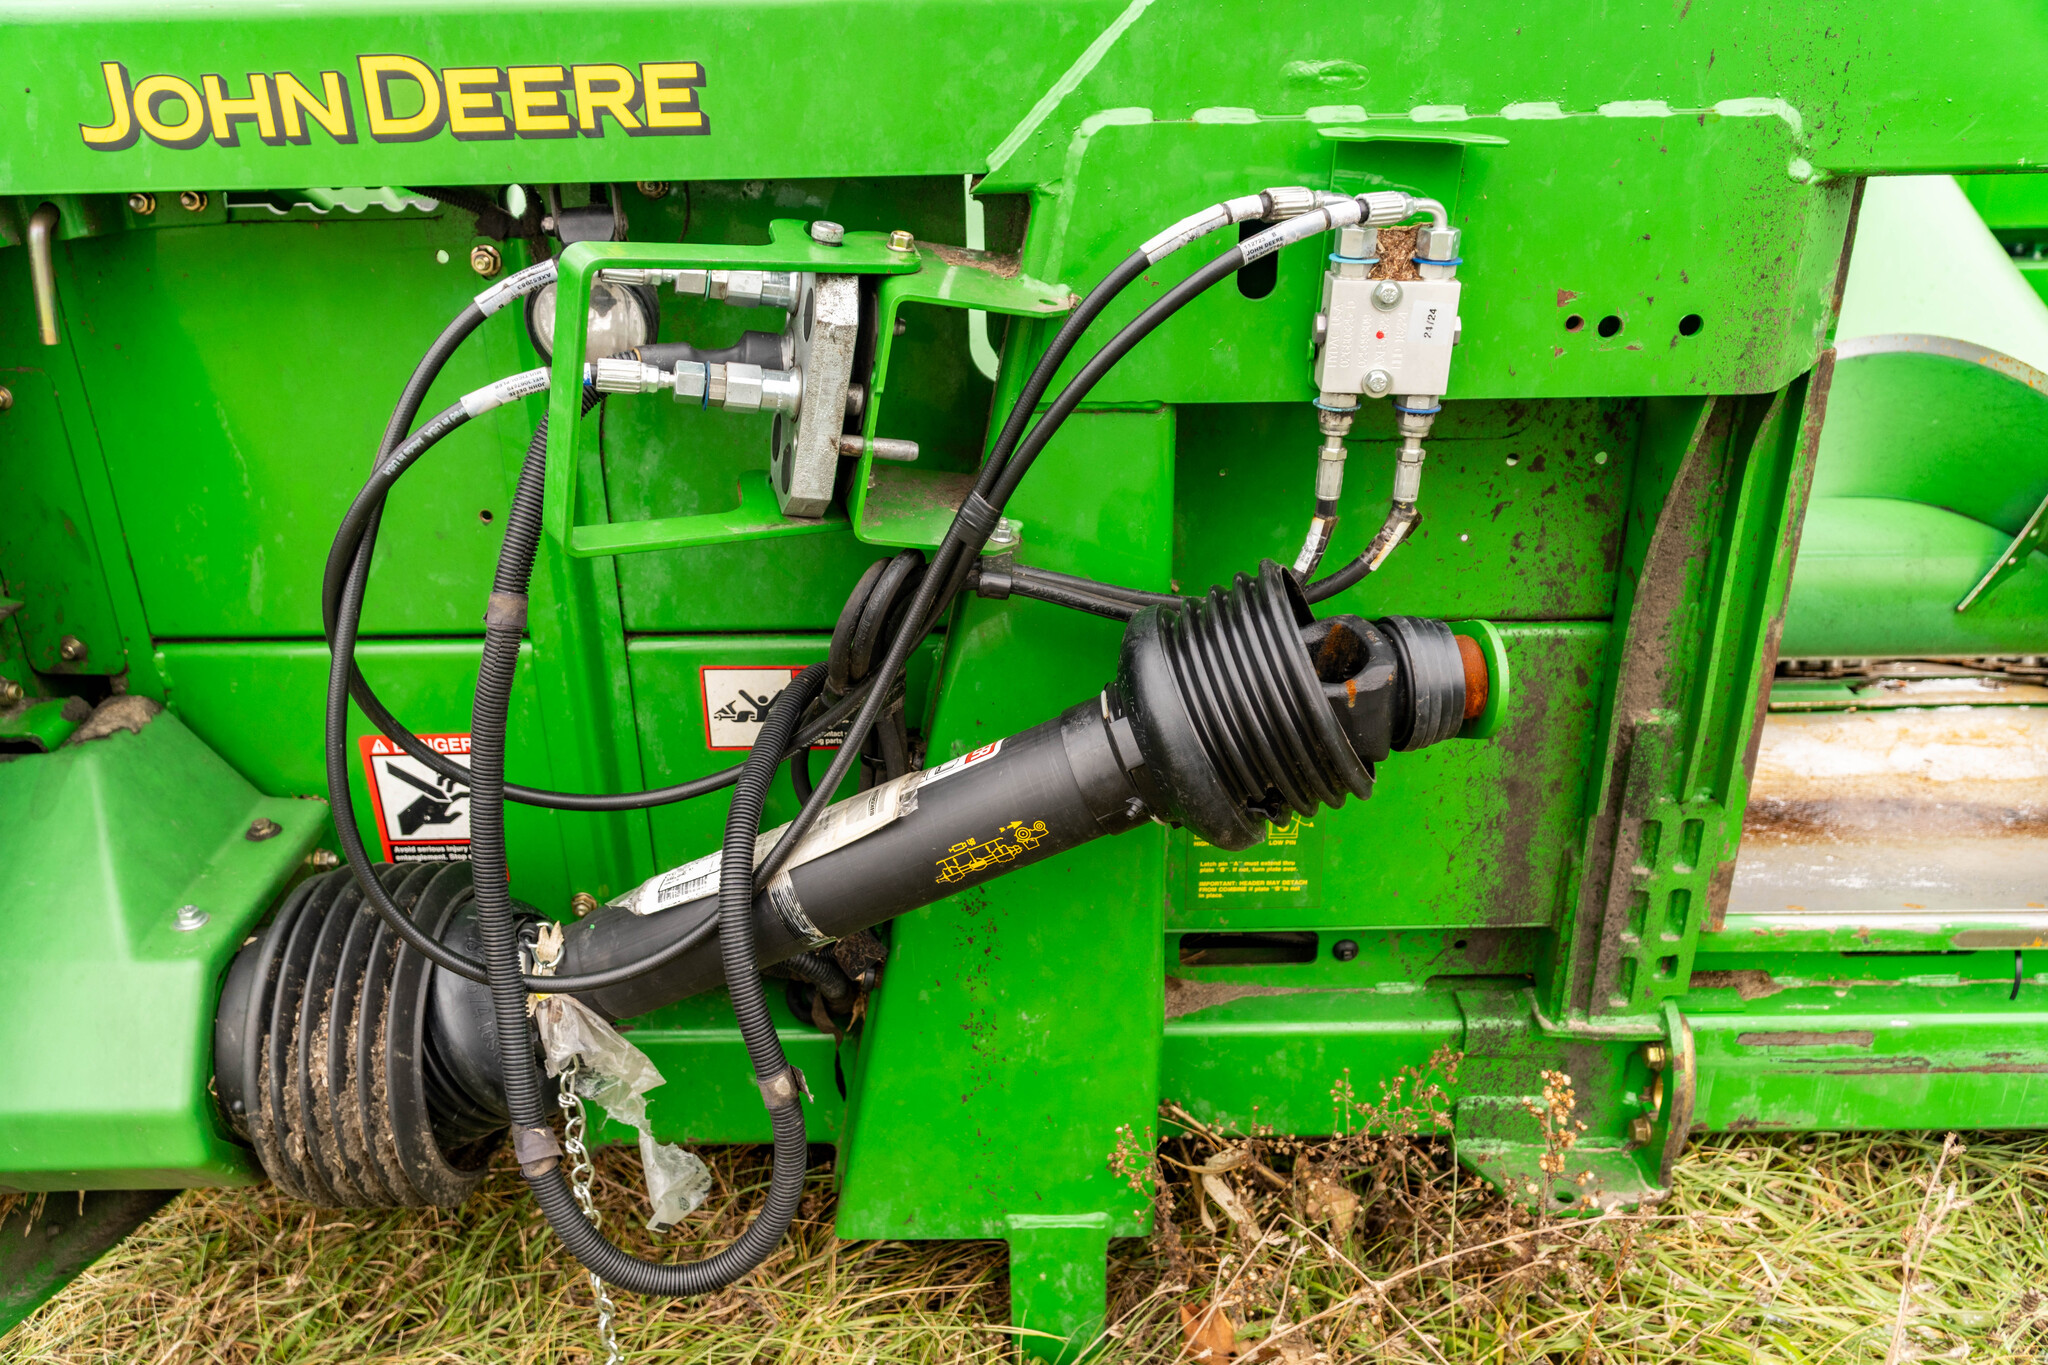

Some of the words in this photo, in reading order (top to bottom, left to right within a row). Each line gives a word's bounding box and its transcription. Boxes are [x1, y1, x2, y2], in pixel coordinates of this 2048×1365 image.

[80, 61, 357, 150] JOHN
[357, 54, 710, 142] DEERE
[1246, 245, 1264, 256] JOHN
[1264, 236, 1284, 249] DEERE
[1424, 308, 1437, 338] 24/24
[509, 387, 525, 398] DEERE
[526, 381, 546, 393] JOHN
[417, 845, 445, 853] serious
[446, 845, 468, 853] injury
[395, 854, 448, 862] entanglement.
